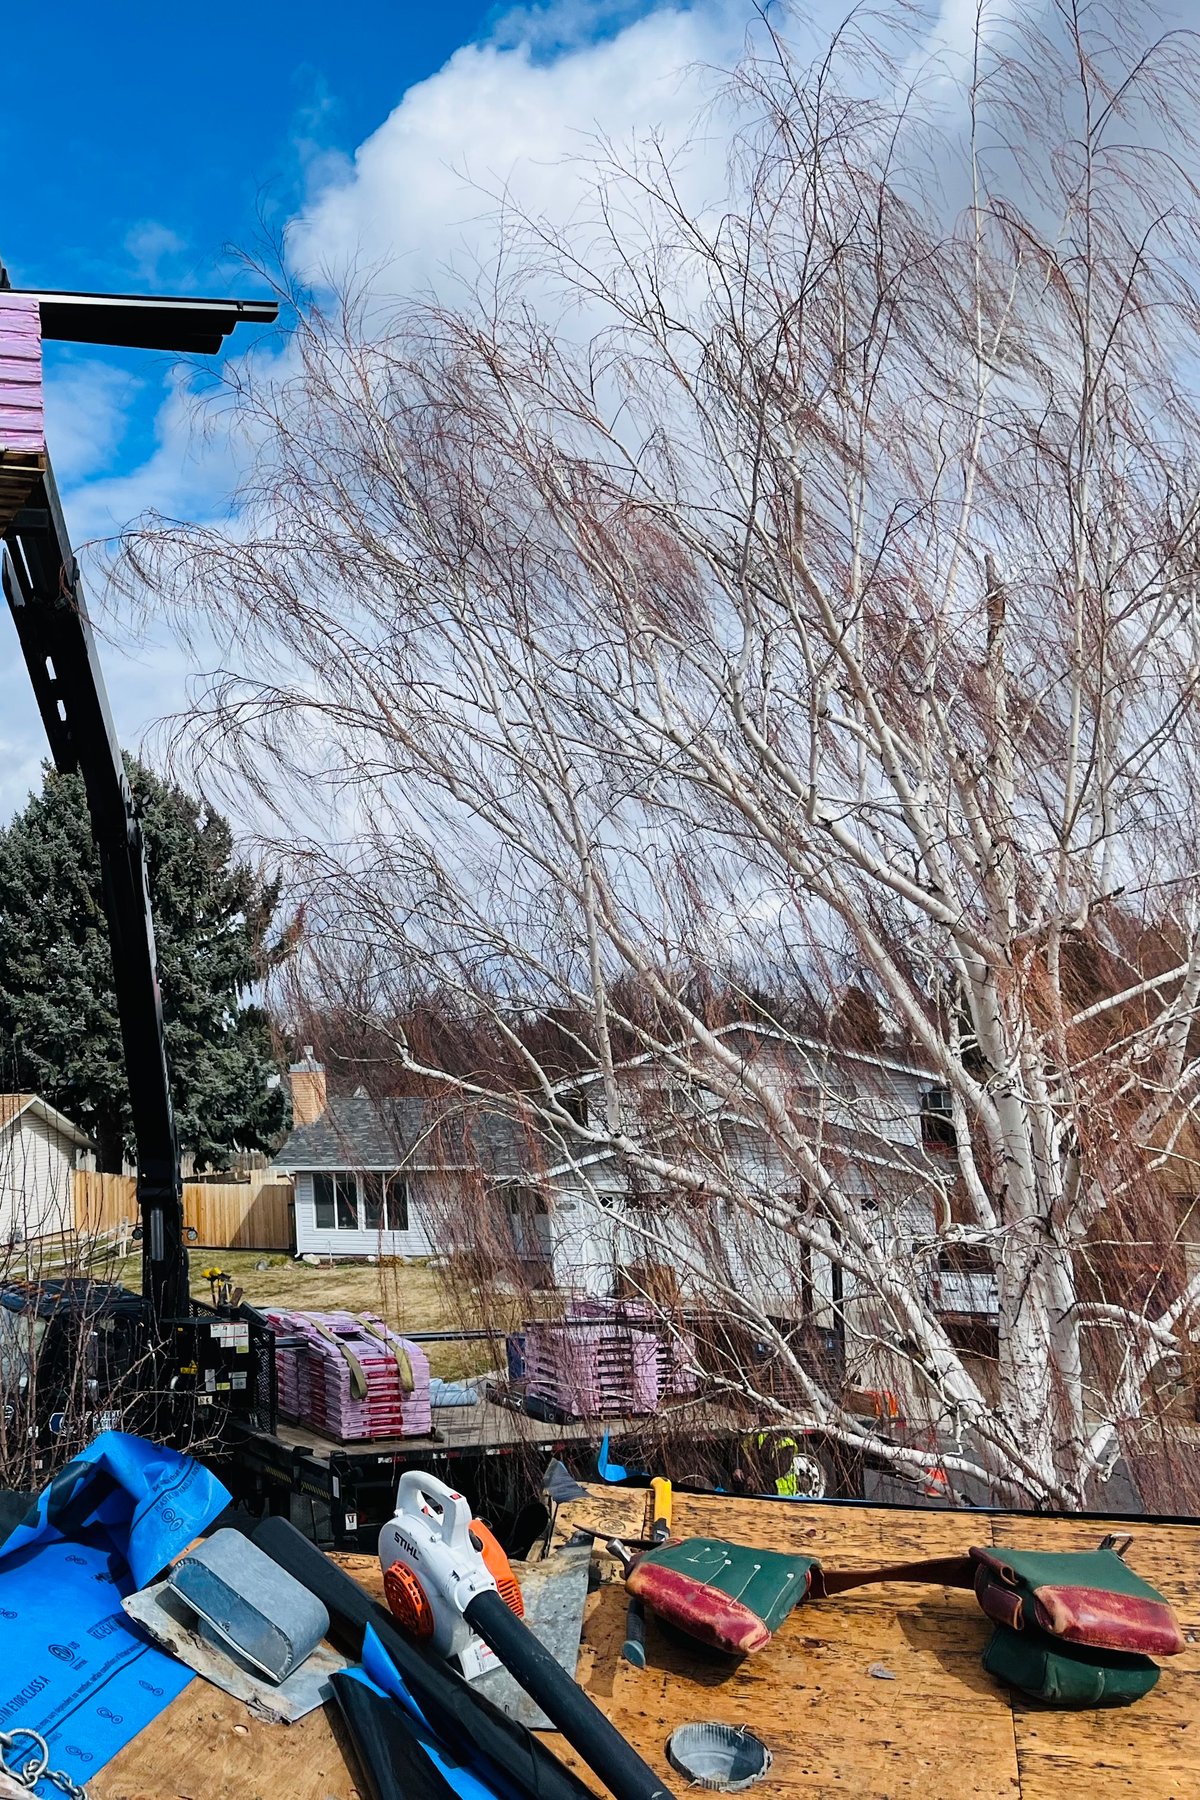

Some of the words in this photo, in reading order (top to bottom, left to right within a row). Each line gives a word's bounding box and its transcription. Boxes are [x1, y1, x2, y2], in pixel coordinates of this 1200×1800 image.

[393, 1531, 420, 1561] STIHL
[6, 1694, 28, 1712] E108
[21, 1679, 46, 1699] CLASS
[38, 1675, 51, 1685] A
